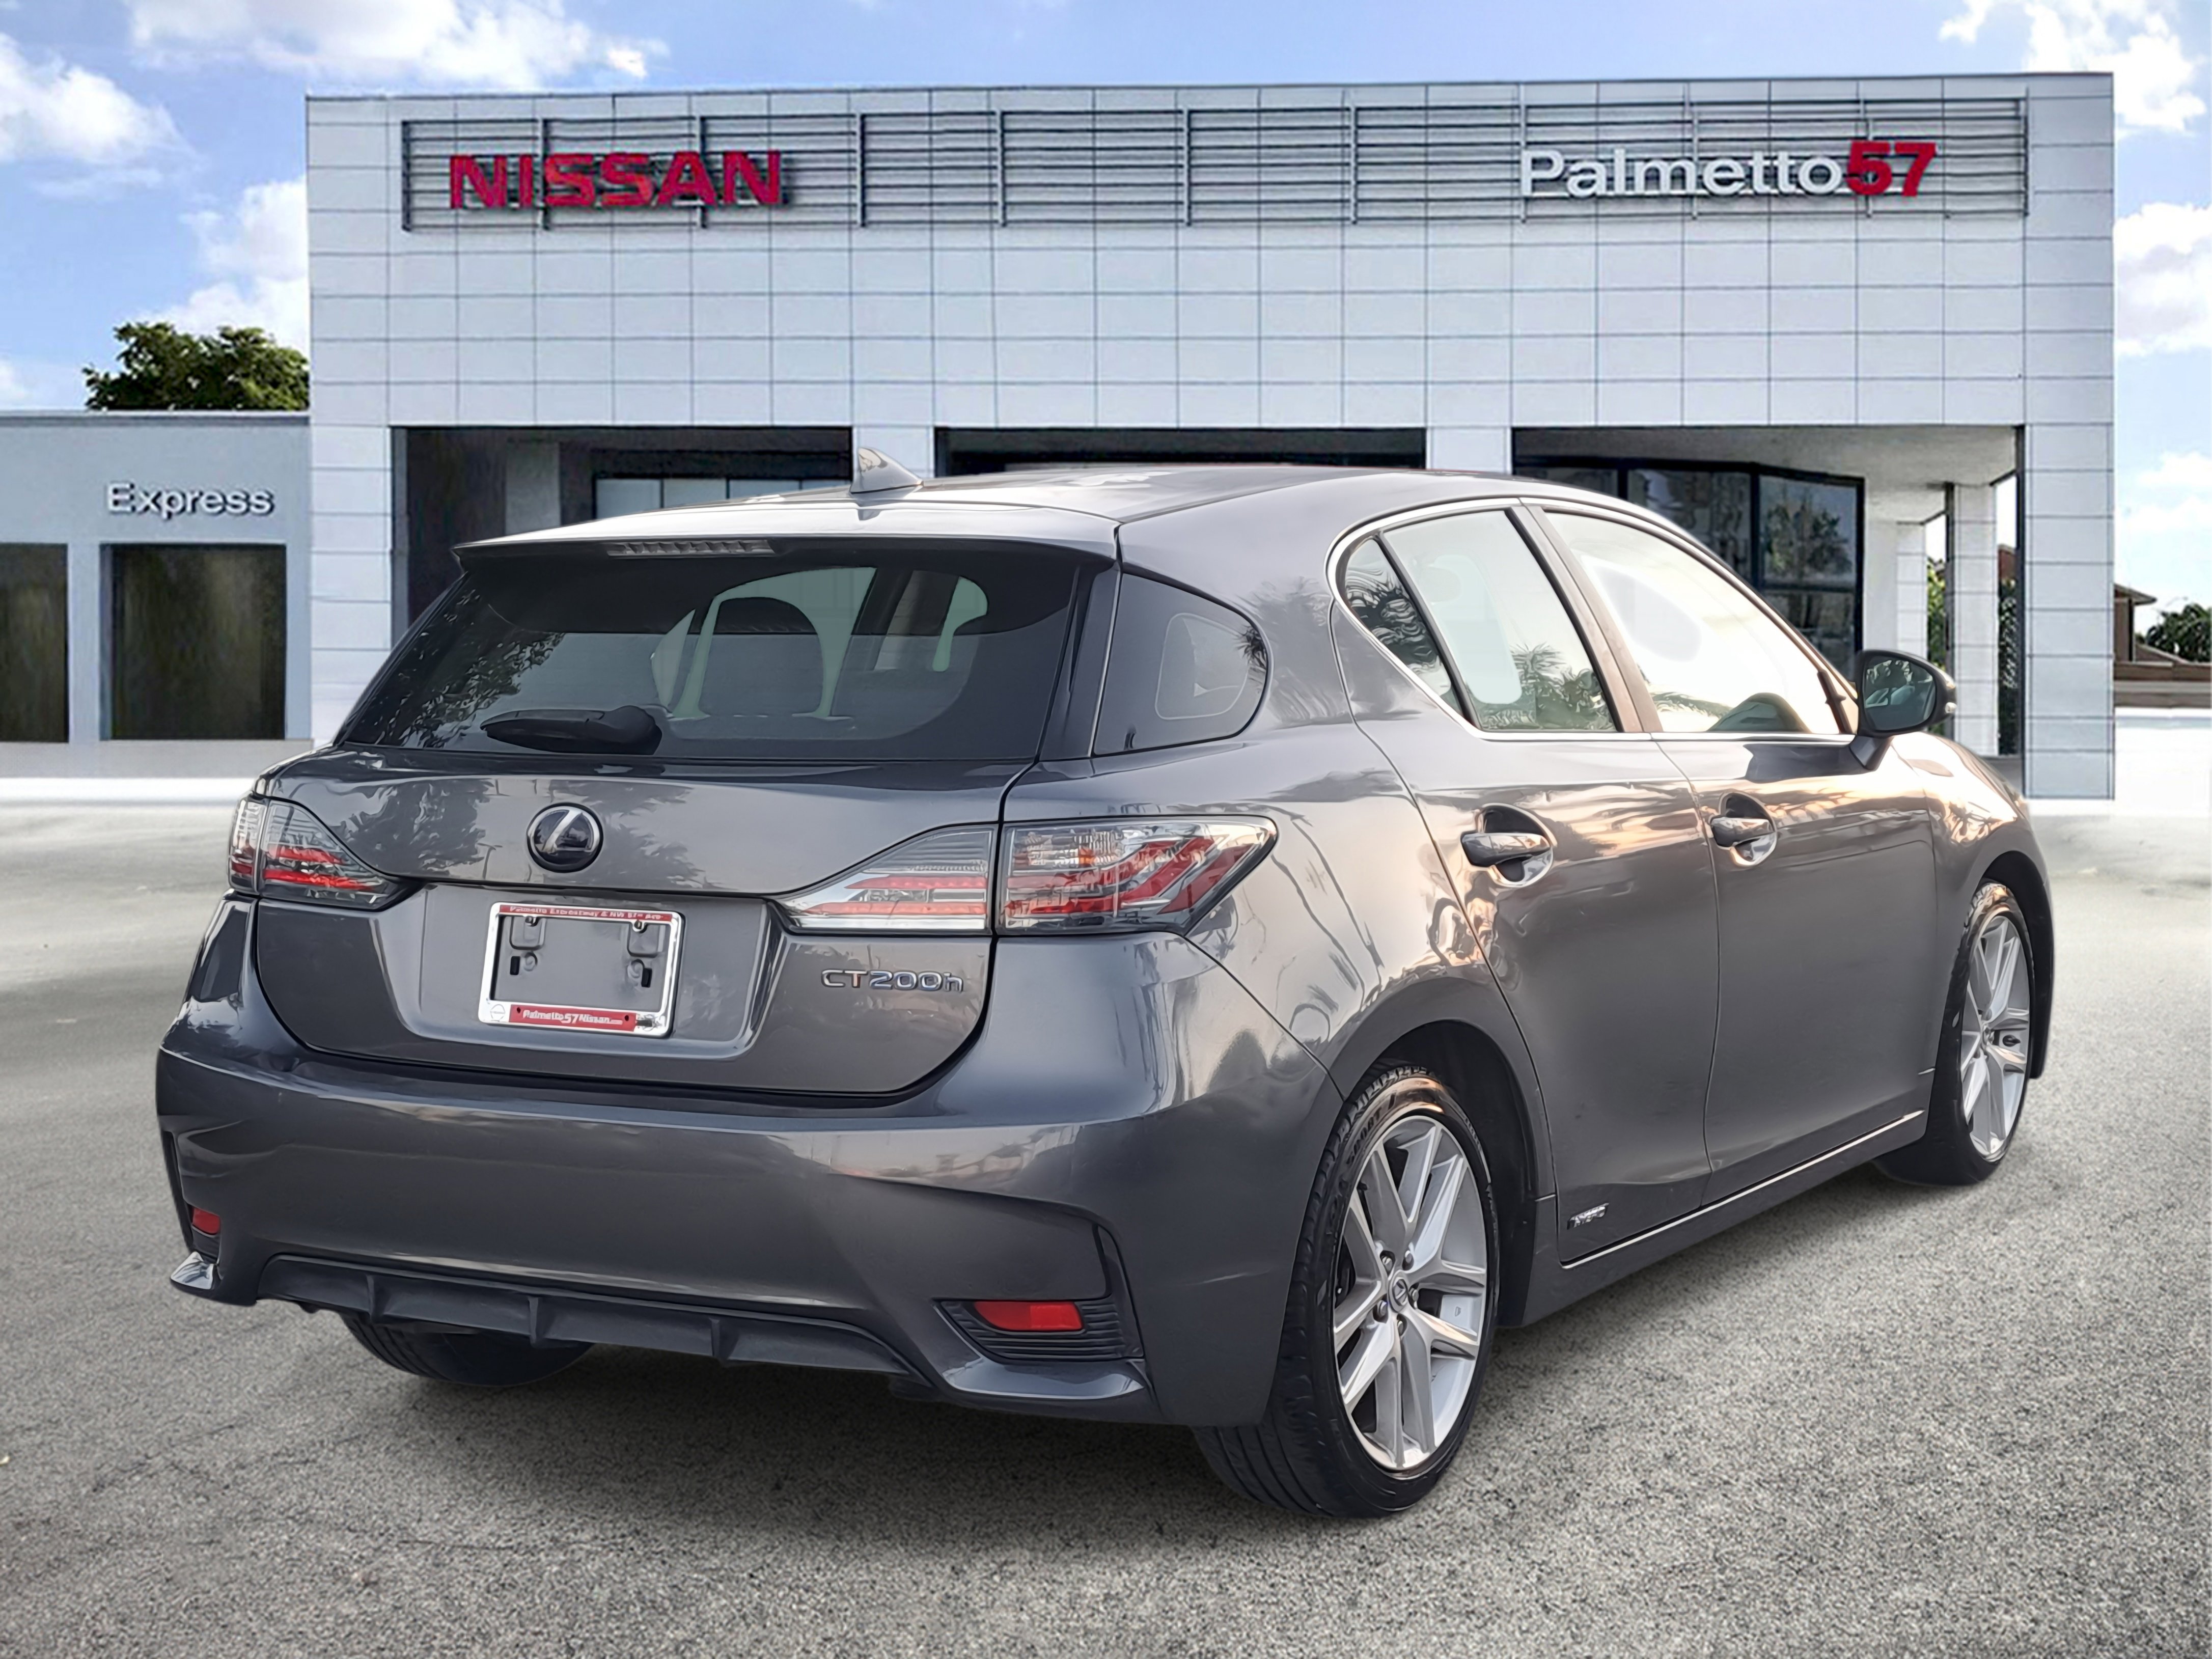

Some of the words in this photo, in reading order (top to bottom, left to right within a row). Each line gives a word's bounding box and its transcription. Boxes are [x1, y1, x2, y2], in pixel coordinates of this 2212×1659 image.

[450, 150, 781, 209] NISSAN
[1521, 141, 1937, 198] Palmetto57
[108, 483, 274, 520] Express
[821, 969, 964, 993] CT200h
